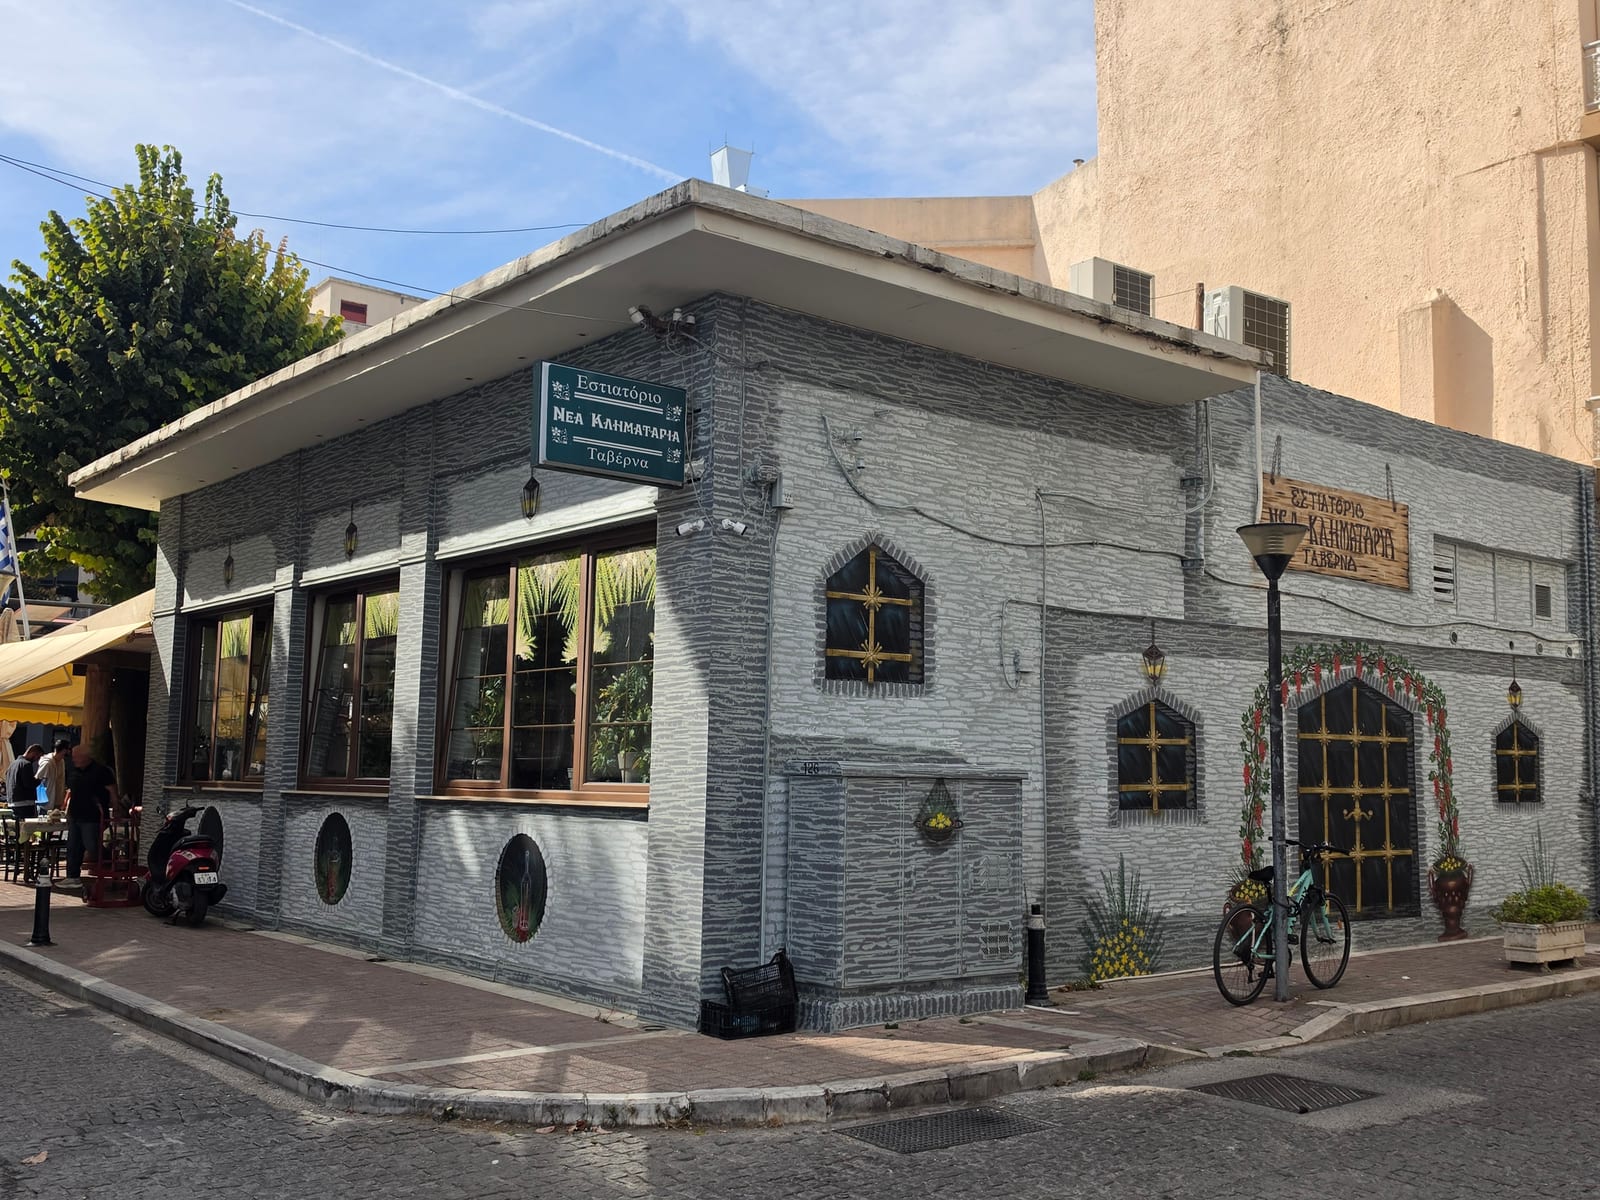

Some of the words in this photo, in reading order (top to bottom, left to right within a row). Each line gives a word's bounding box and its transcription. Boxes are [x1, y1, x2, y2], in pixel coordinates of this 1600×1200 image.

[577, 374, 662, 404] Εστιατόριο
[587, 447, 649, 469] Ταβέρνα
[1302, 548, 1357, 572] ΤΑΒΕΡΝΑ
[804, 762, 819, 775] 126
